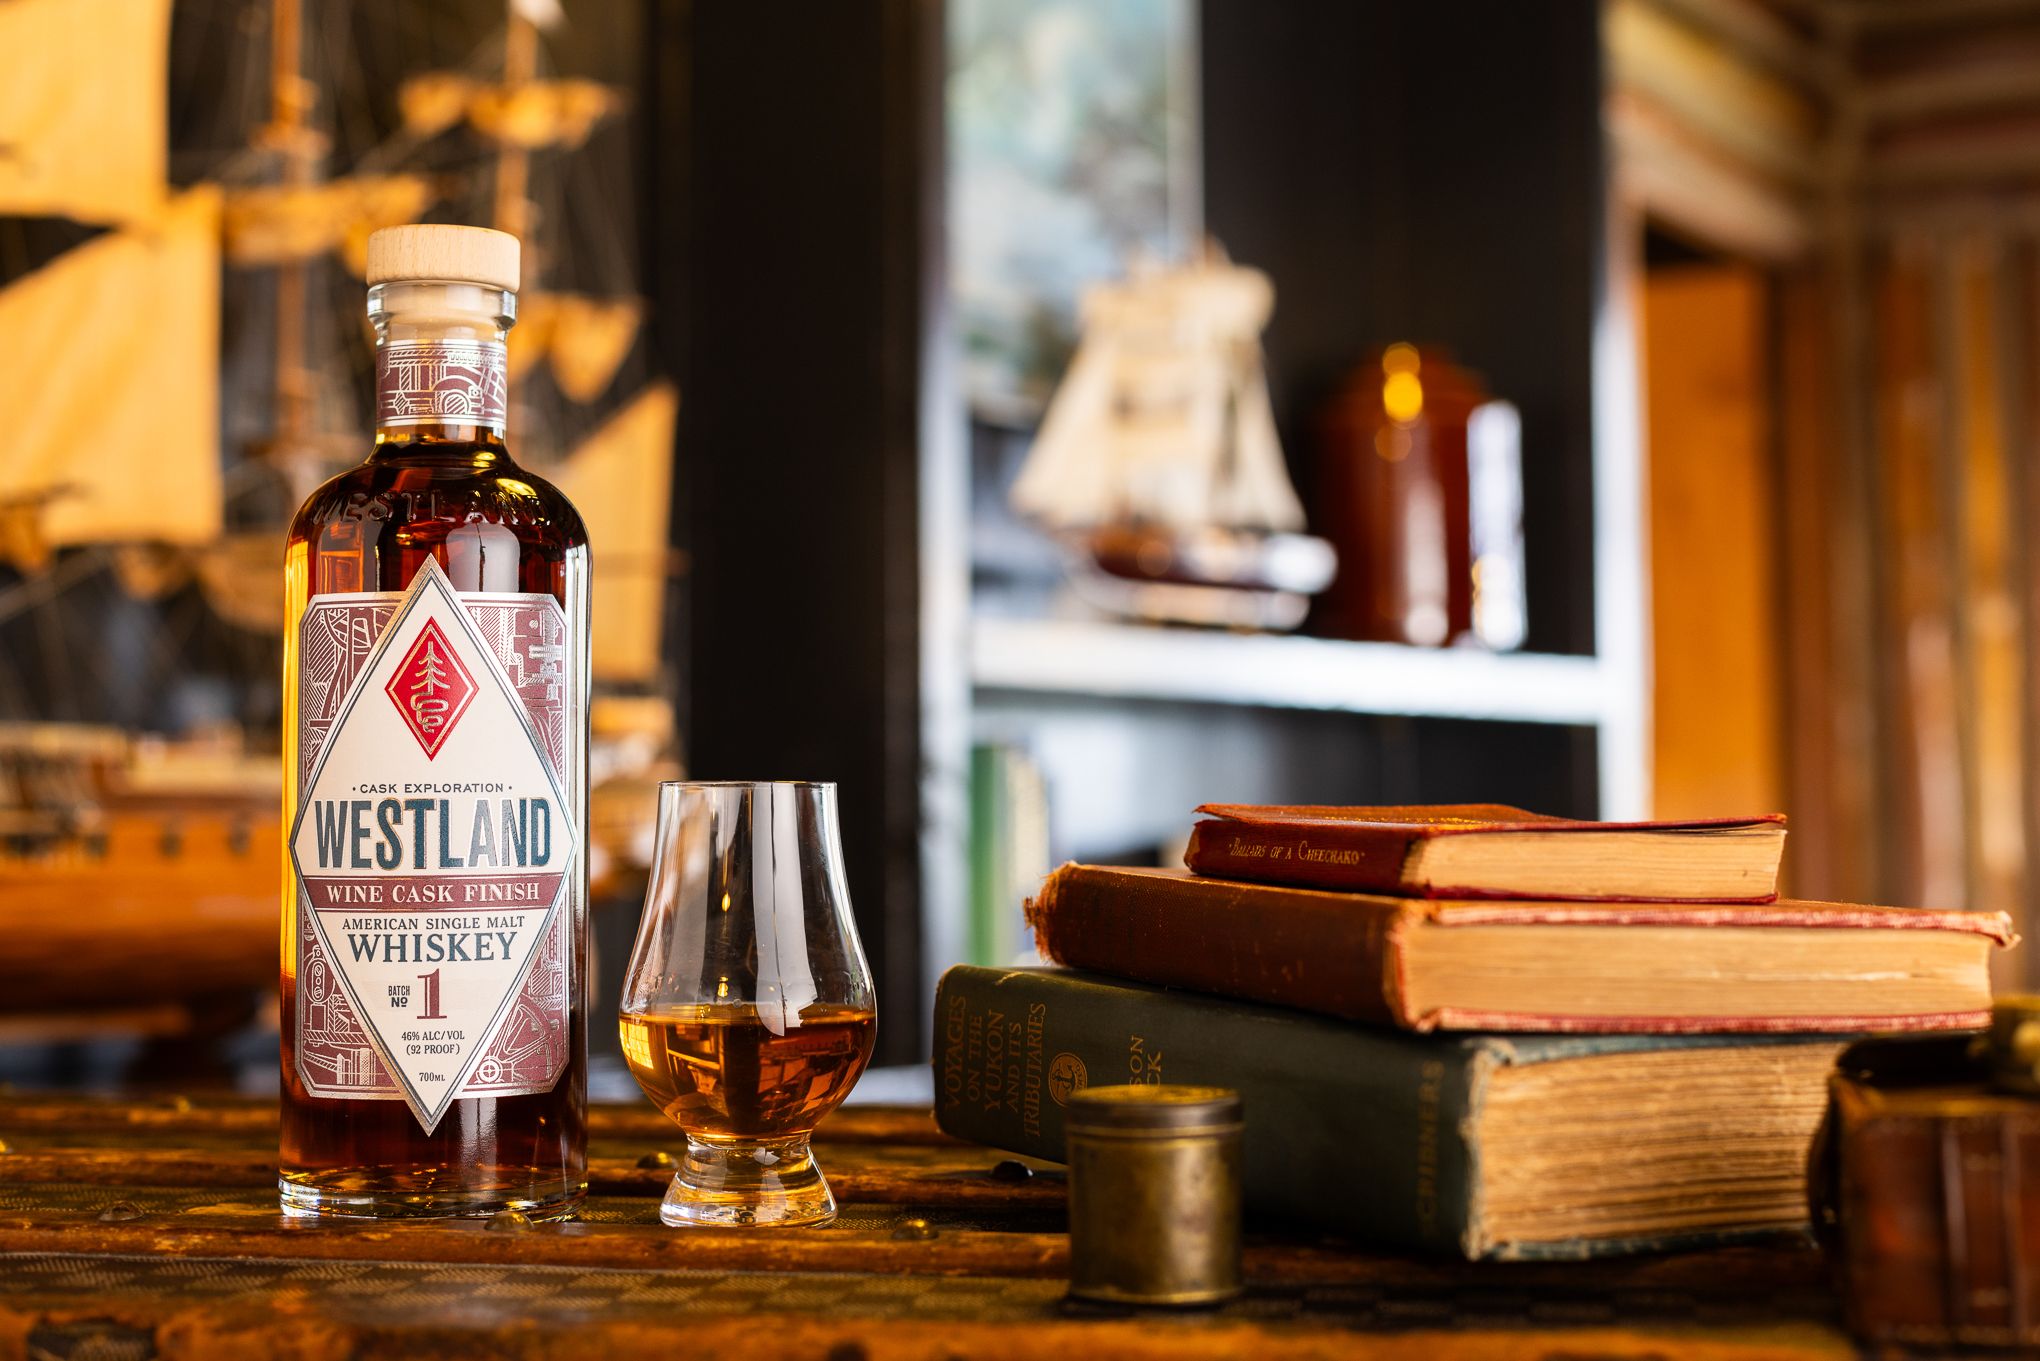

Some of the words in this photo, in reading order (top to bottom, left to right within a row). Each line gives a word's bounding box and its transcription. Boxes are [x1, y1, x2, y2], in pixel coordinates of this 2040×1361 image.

[359, 783, 398, 794] CASK
[404, 783, 504, 794] EXPLORATION
[314, 797, 551, 870] WESTLAND
[326, 885, 384, 903] WINE
[392, 884, 454, 903] CASK
[464, 882, 540, 901] FINISH
[342, 918, 419, 931] AMERICAN
[426, 917, 480, 930] SINGLE
[486, 915, 525, 928] MALT
[347, 931, 518, 963] WHISKEY
[388, 985, 411, 996] BATCH
[416, 968, 447, 1020] 1
[401, 1031, 420, 1041] 46%
[422, 1030, 465, 1041] ALC/VOL
[406, 1044, 421, 1055] (92
[424, 1044, 460, 1055] PROOF)
[944, 995, 967, 1111] VOYAGES
[968, 1015, 983, 1059] THE
[1008, 1022, 1022, 1057] ITS
[983, 1009, 1005, 1112] YUKON
[1024, 1003, 1045, 1138] TRIBUTARIES
[1129, 1035, 1143, 1087] SON
[967, 1069, 981, 1102] ON
[1007, 1065, 1022, 1114] AND
